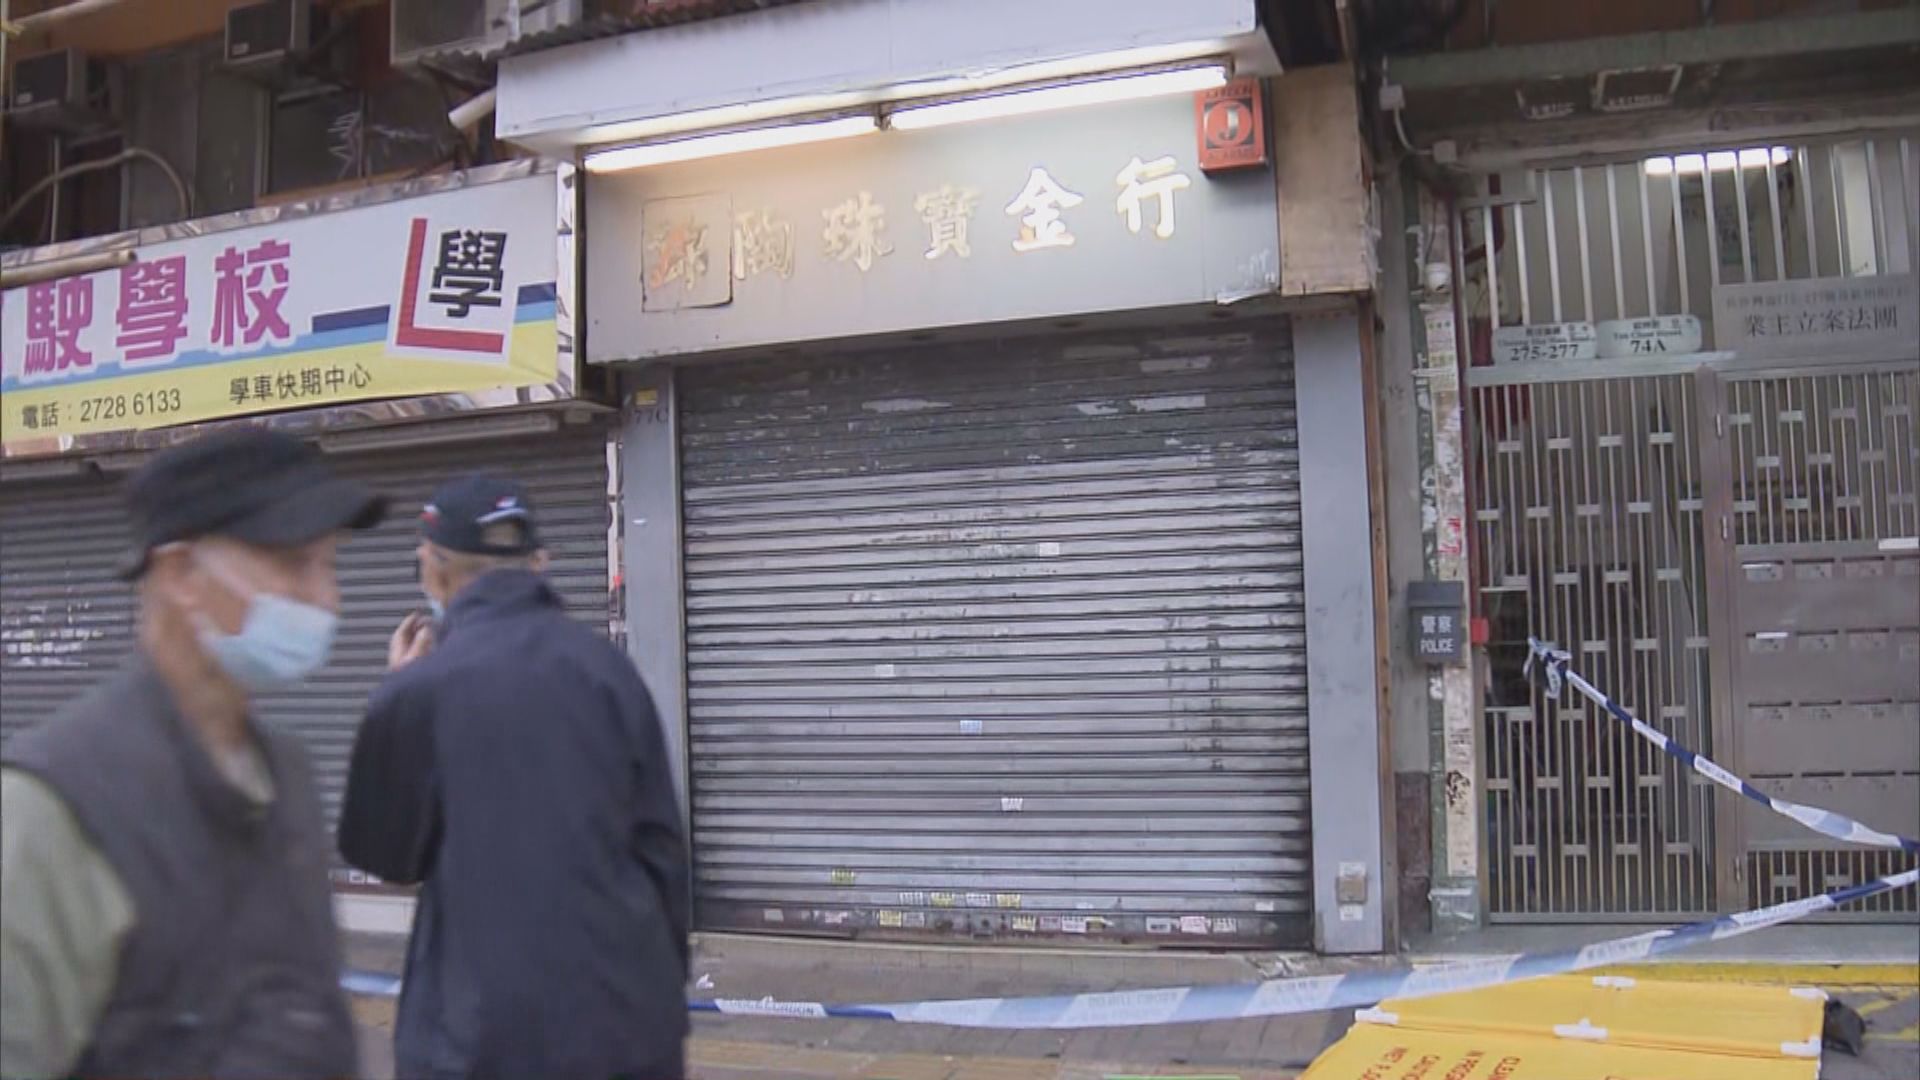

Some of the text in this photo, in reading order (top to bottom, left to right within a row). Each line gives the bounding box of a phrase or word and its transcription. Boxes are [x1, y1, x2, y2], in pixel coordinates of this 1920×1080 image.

[429, 229, 508, 318] 學
[23, 239, 291, 375] 駛學校
[1744, 304, 1898, 338] 業主立案法團
[1510, 343, 1579, 362] 275-277
[1629, 339, 1667, 353] 74A
[229, 362, 372, 406] 學車快期中心
[80, 395, 128, 422] 2728
[132, 388, 182, 416] 6133
[1421, 615, 1453, 634] 警察
[1420, 638, 1455, 653] POLICE
